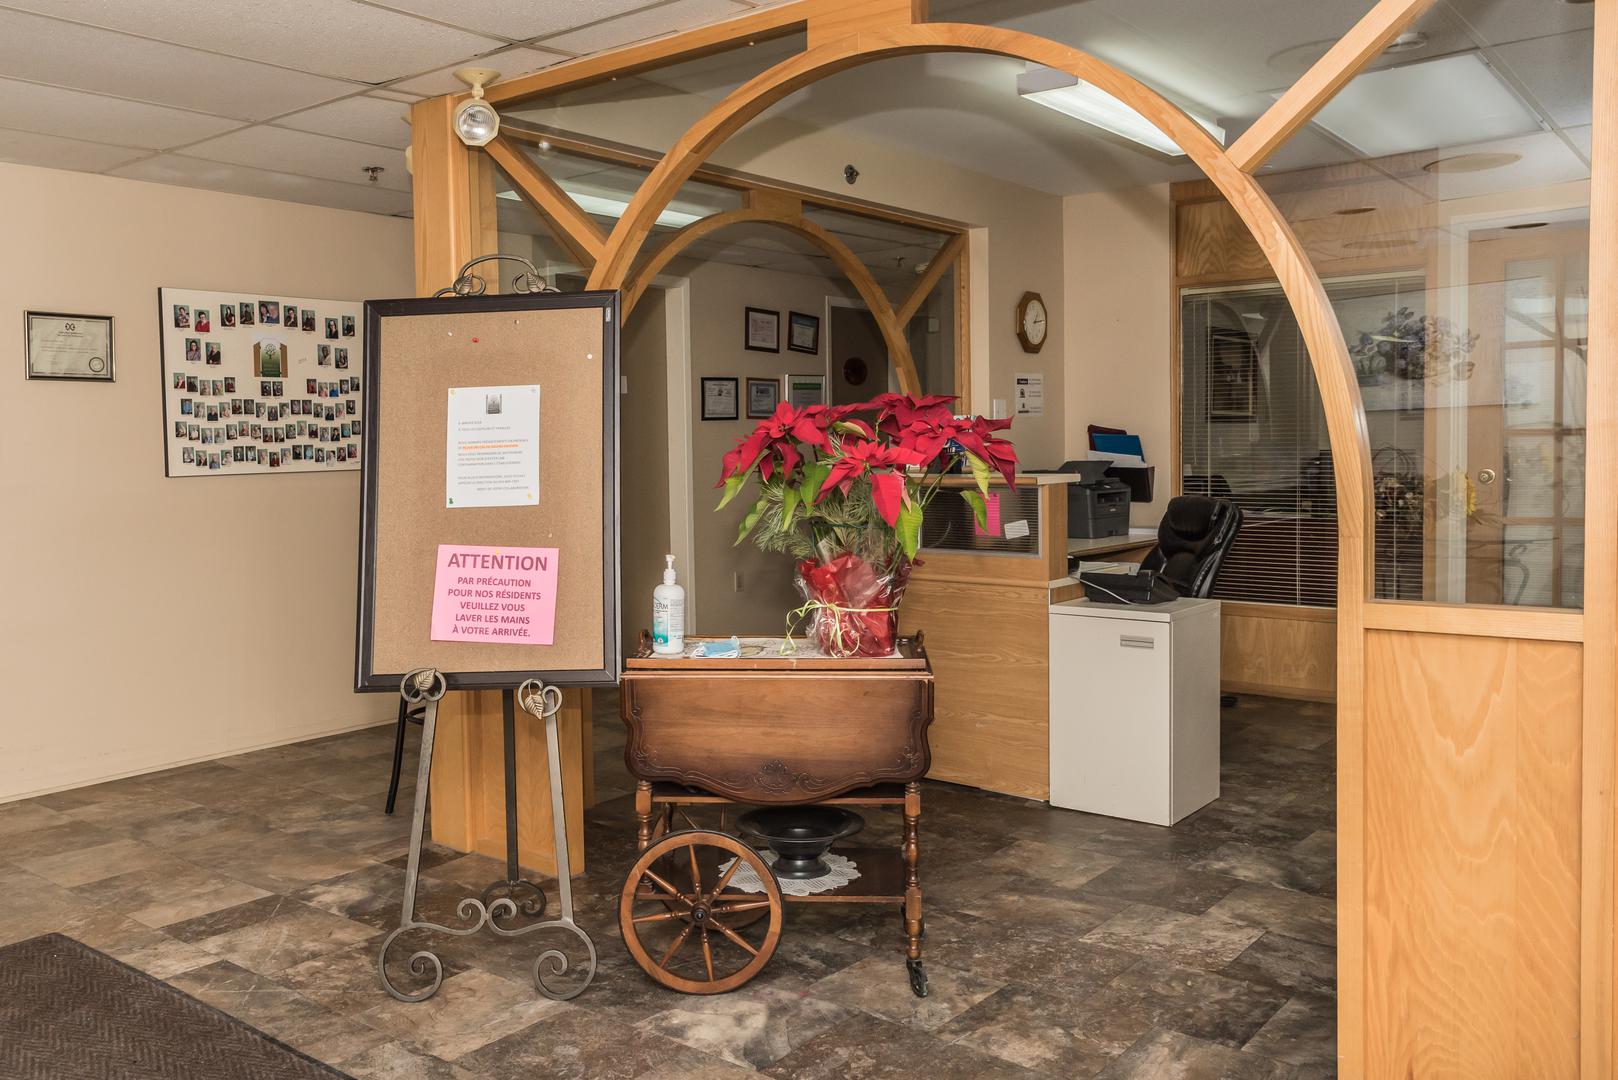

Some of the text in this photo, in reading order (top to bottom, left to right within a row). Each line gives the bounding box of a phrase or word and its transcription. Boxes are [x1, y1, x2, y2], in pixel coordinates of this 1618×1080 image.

[447, 553, 548, 572] ATTENTION
[458, 576, 532, 587] PAR PRÉCAUTION
[448, 589, 541, 600] POUR NOS RÉSIDENTS
[460, 602, 526, 612] VEUILLEZ VOUS
[456, 614, 530, 624] LAVER LES MAINS
[452, 624, 530, 637] À VOTRE ARRIVÉE.
